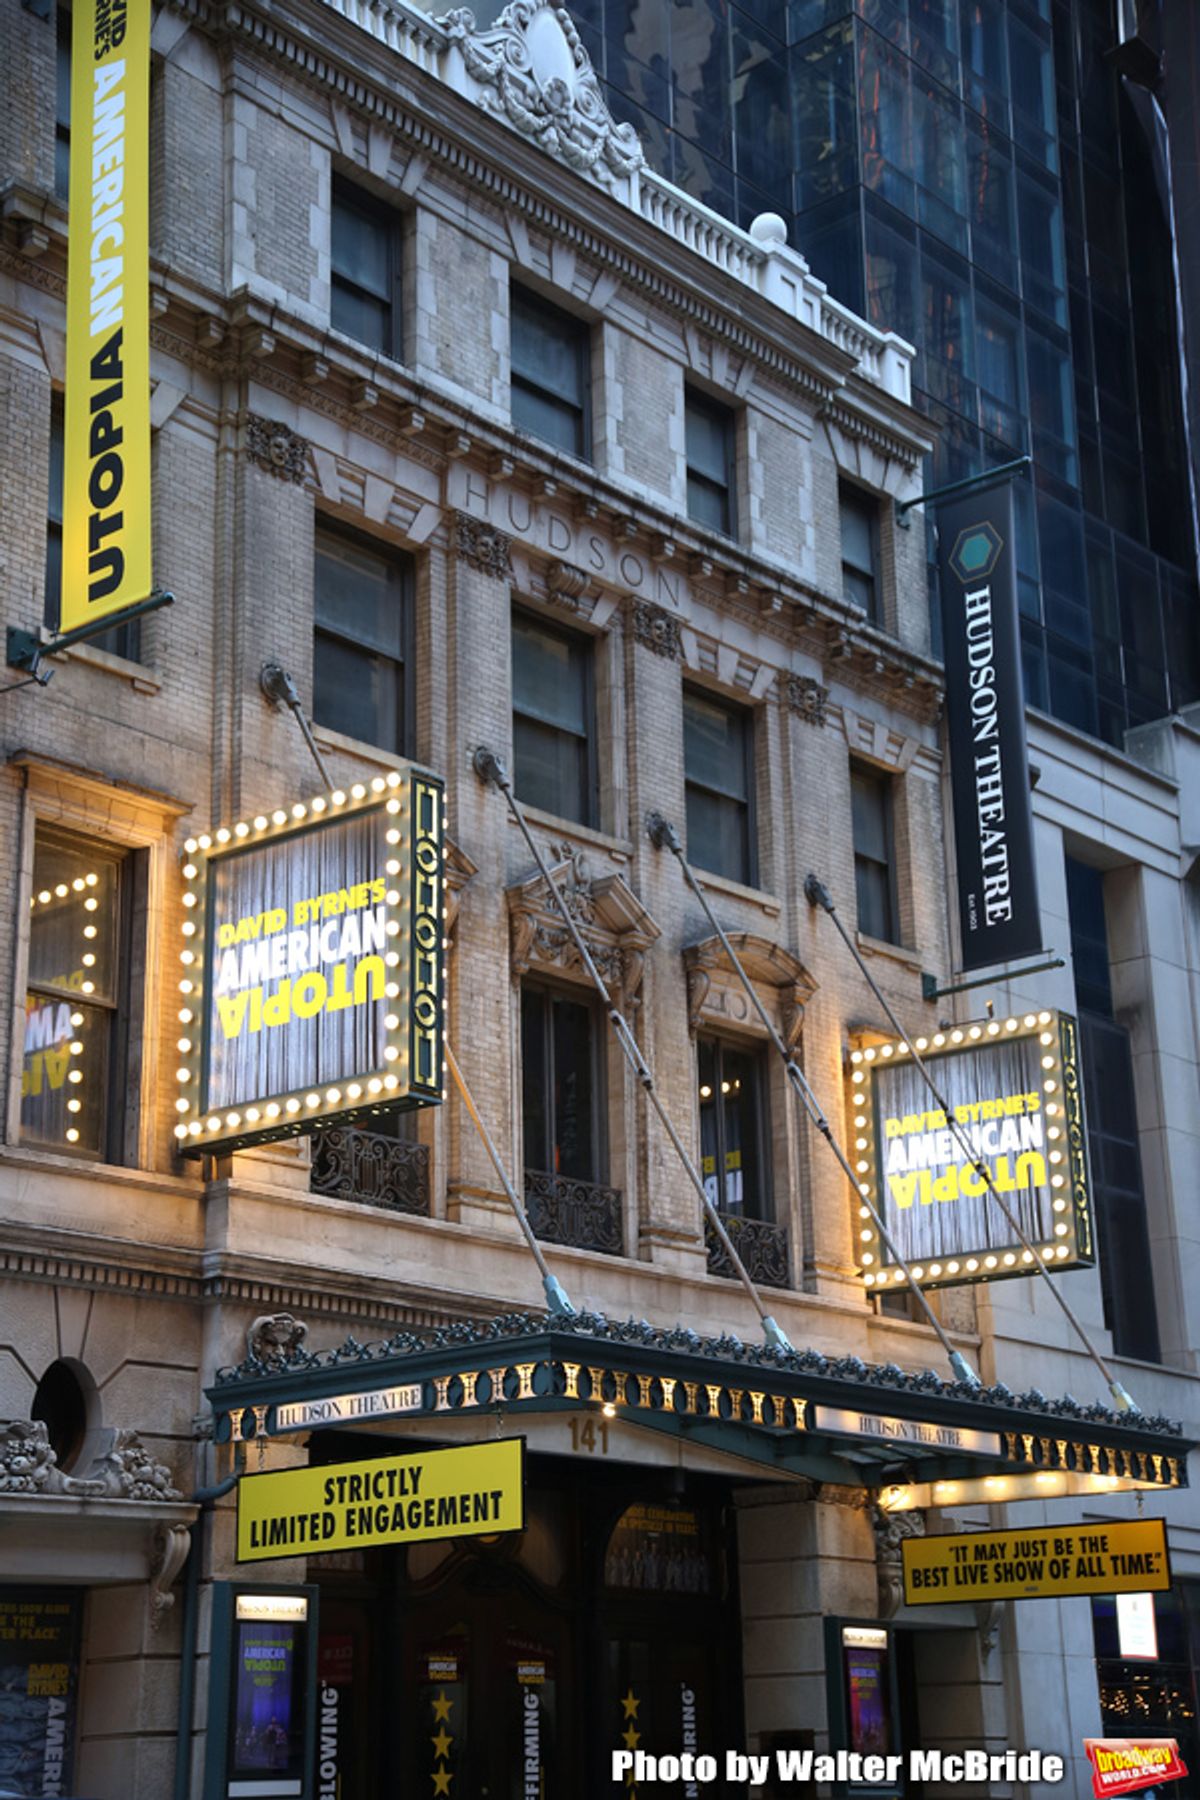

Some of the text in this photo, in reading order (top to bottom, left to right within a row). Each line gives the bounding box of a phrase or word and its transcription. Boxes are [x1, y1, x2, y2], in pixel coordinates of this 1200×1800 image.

[89, 58, 126, 337] AMERICAN
[88, 325, 125, 603] UTOPIA
[465, 473, 681, 608] HUDSON
[964, 585, 1013, 926] HUDSON THEATRE
[218, 877, 387, 949] DAVID BYRNE'S
[215, 905, 387, 995] AMERICAN
[216, 954, 387, 1040] UTOPIA
[886, 1092, 1042, 1137] DAVID BYRNE'S
[887, 1113, 1044, 1175] AMERICAN
[887, 1151, 1047, 1210] UTOPIA
[279, 1388, 421, 1426] HUDSON THEATRE
[567, 1416, 608, 1455] 141
[860, 1416, 963, 1447] HUDSON THEATRE
[323, 1466, 424, 1506] STRICTLY
[250, 1490, 503, 1548] LIMITED ENGAGEMENT
[973, 1542, 1007, 1562] MAY
[1013, 1540, 1048, 1559] JUST
[1054, 1538, 1073, 1556] BE
[1079, 1535, 1109, 1553] THE
[912, 1567, 948, 1589] BEST
[954, 1564, 988, 1586] LIVE
[994, 1559, 1044, 1583] SHOW
[1050, 1558, 1071, 1580] OF
[1076, 1555, 1105, 1577] ALL
